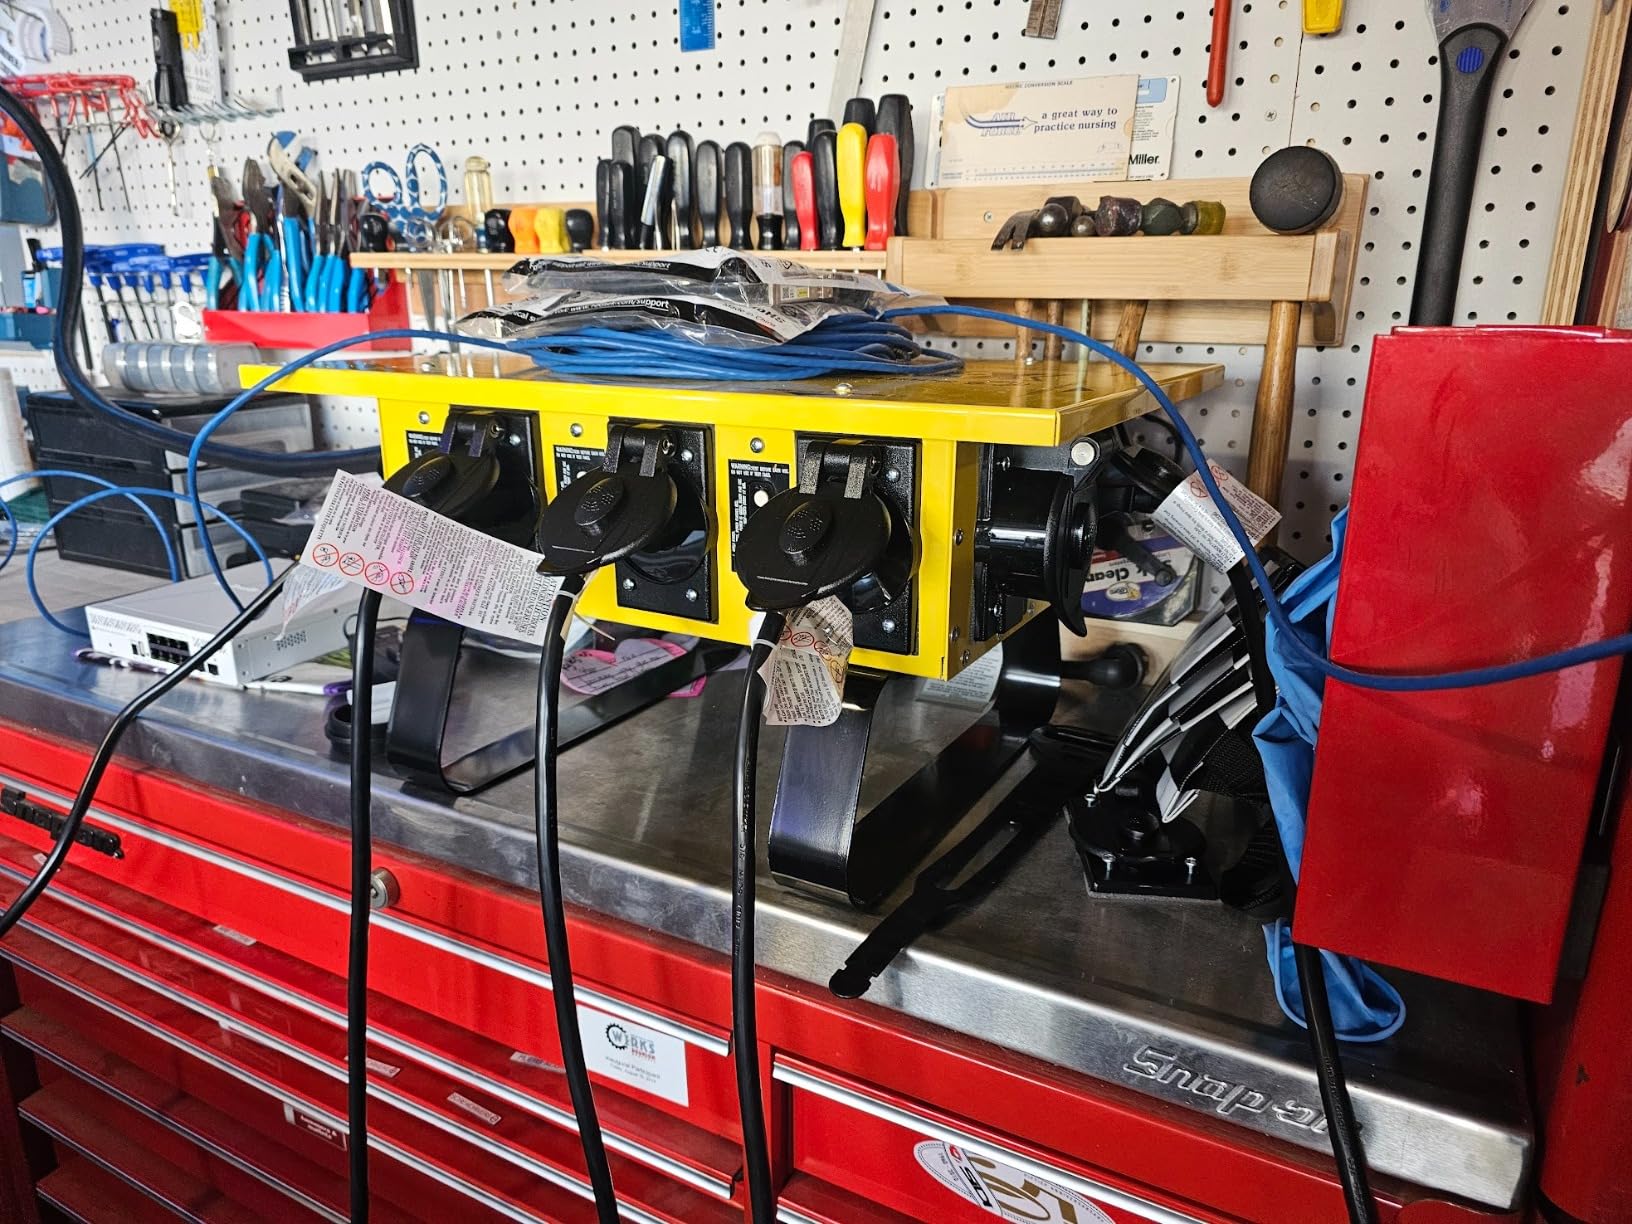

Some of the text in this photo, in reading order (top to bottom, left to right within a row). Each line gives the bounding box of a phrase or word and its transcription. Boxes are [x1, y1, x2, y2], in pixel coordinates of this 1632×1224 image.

[1041, 107, 1119, 120] a great way to
[1033, 119, 1118, 134] practice nursing
